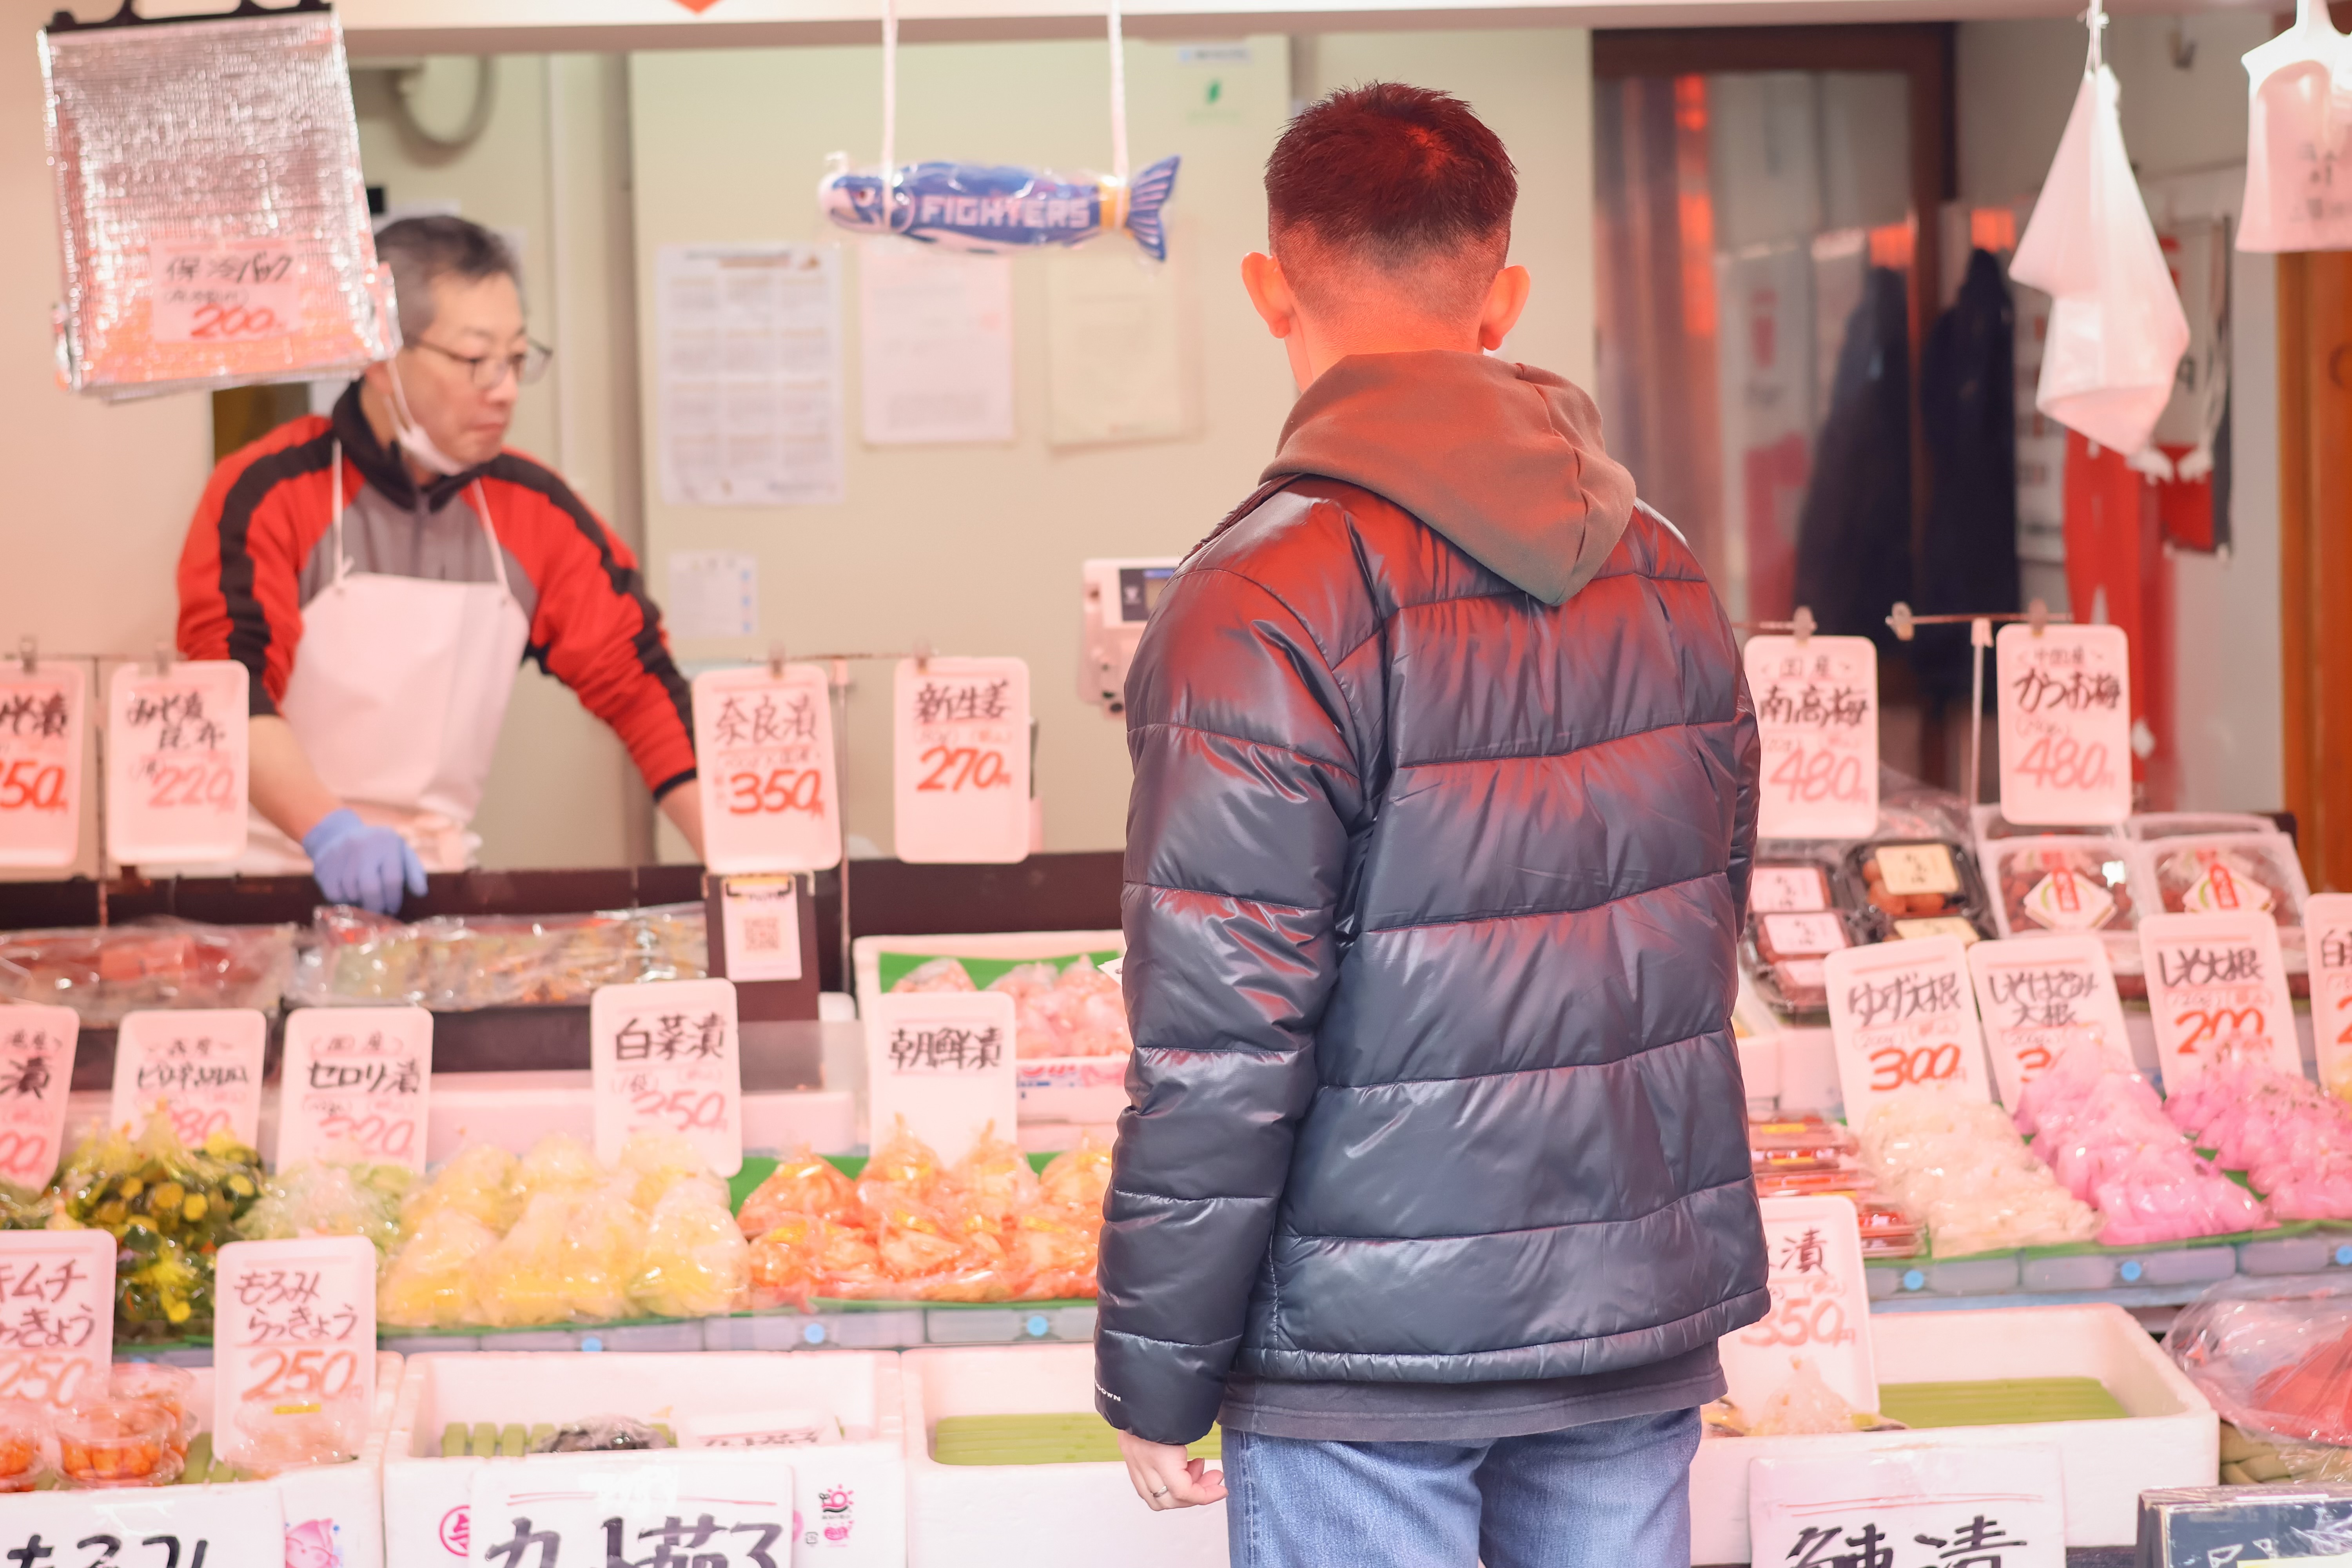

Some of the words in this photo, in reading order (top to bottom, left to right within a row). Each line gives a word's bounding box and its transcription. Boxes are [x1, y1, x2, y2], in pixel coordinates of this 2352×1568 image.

[919, 195, 1091, 229] FIGHTERS
[714, 693, 818, 745] 奈良漬
[915, 680, 1010, 724] 新生姜
[1759, 685, 1869, 728] 南高梅
[615, 1012, 726, 1062] 白菜漬
[889, 1026, 1004, 1070] 朝鮮漬
[308, 1058, 421, 1094] セロリ漬
[234, 1270, 321, 1306] もろみ
[247, 1303, 358, 1345] らっきょう
